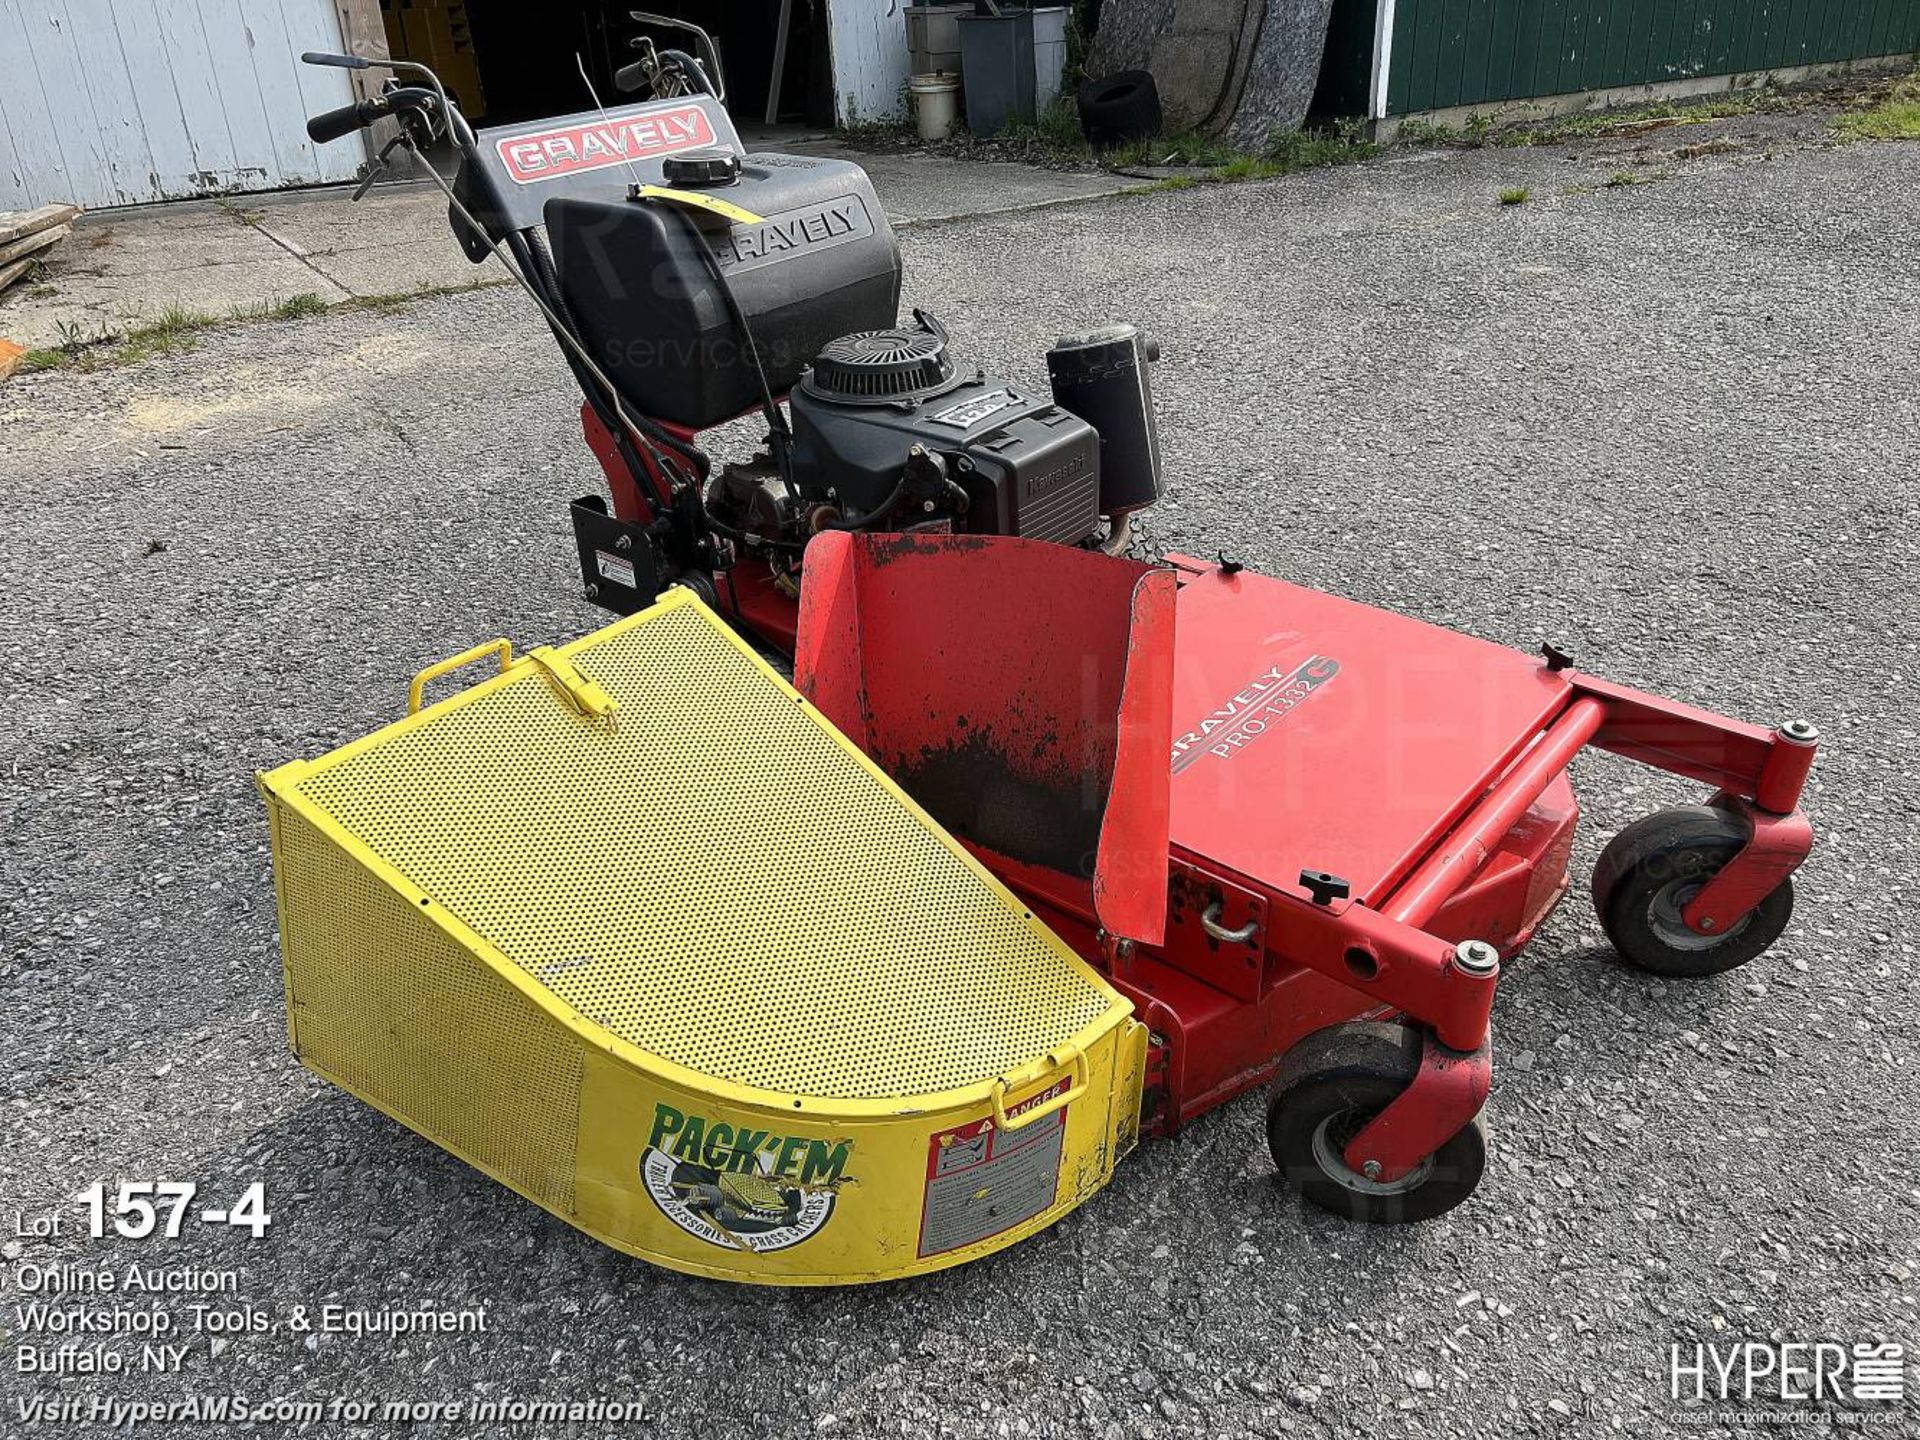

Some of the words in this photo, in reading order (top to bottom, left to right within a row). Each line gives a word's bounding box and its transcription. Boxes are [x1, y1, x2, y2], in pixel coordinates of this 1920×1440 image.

[508, 111, 698, 173] GRAVELY
[1171, 664, 1284, 761] RAVELY
[1009, 1086, 1061, 1120] ANGER
[748, 1231, 790, 1248] GRASS
